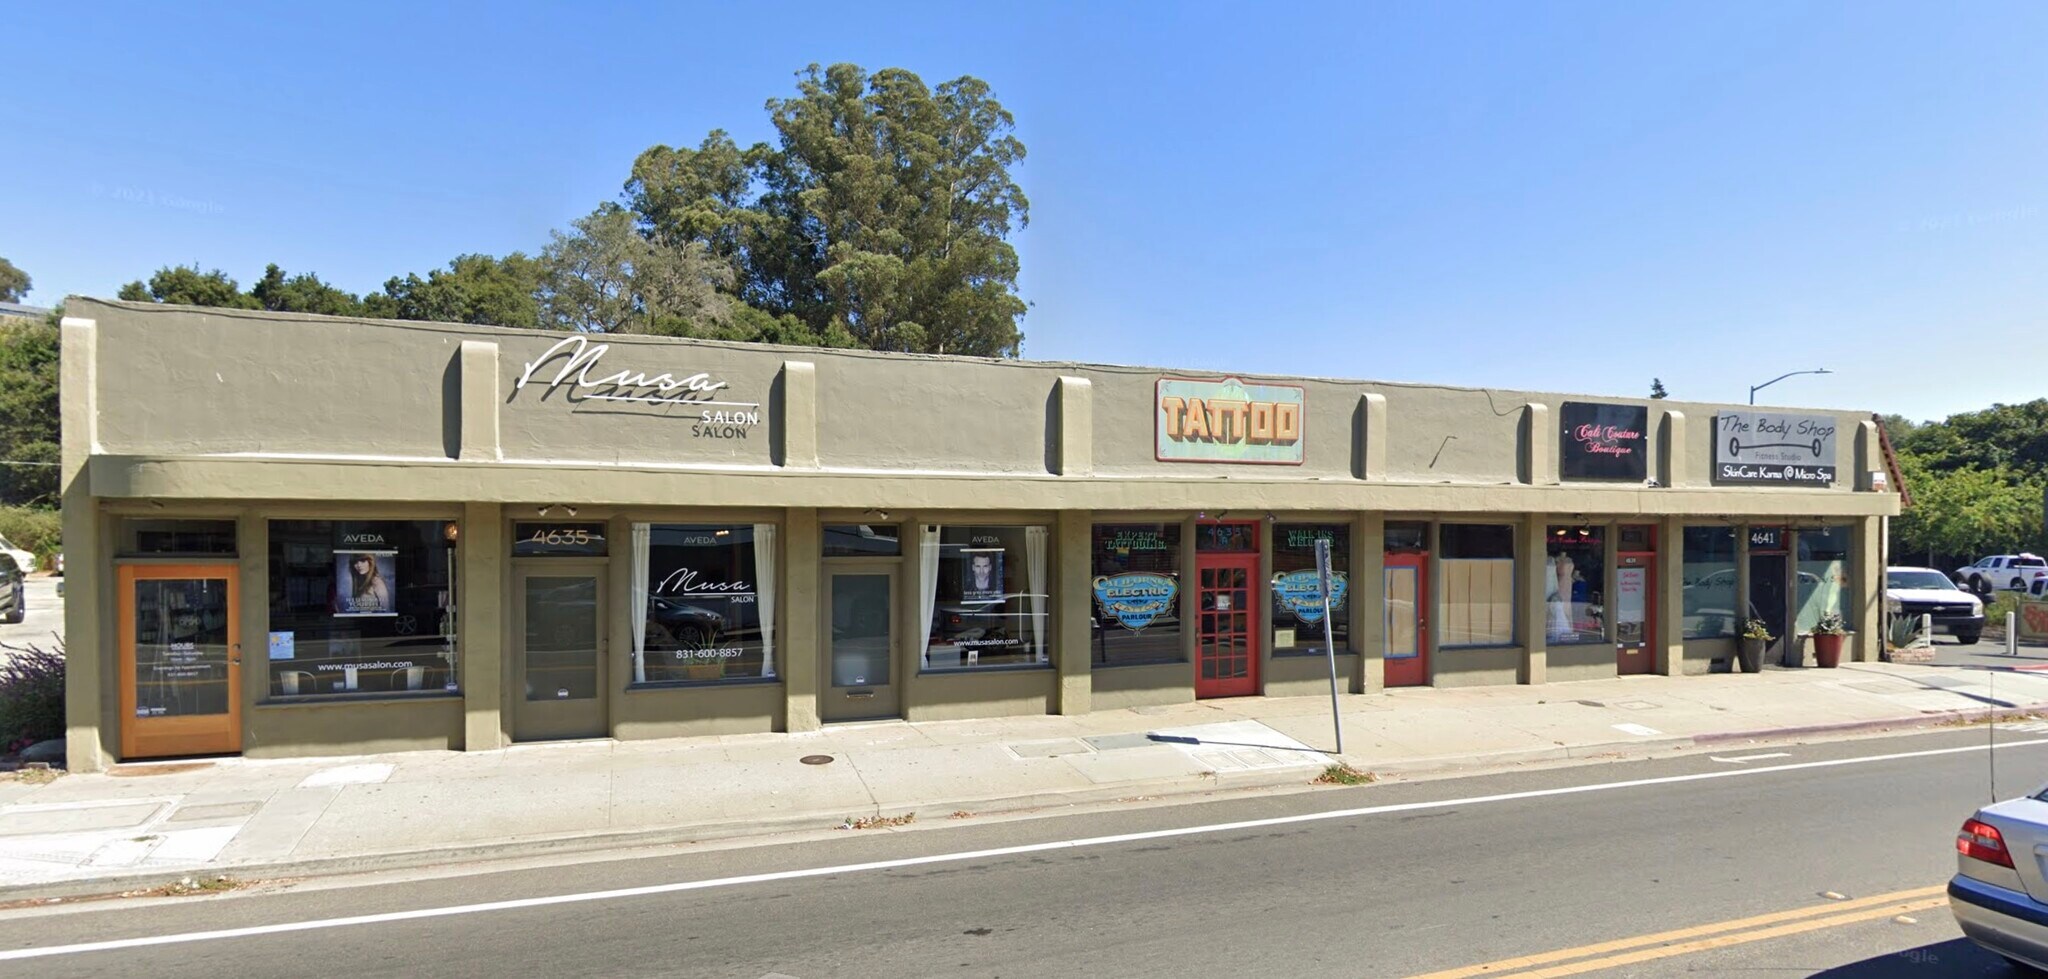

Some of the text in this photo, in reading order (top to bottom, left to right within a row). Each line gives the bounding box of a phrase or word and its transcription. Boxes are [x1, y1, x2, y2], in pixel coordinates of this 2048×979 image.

[517, 335, 727, 392] Musa
[702, 410, 758, 425] SALON
[1162, 397, 1299, 445] TATTOO
[1574, 423, 1640, 442] Cali Couture
[1720, 415, 1835, 440] The Body Shop
[1585, 441, 1633, 458] Boutique
[1755, 452, 1802, 461] Fitness Studio
[1723, 465, 1758, 478] SkinCare
[1758, 466, 1783, 479] Karma
[1795, 467, 1815, 480] Micro
[1816, 468, 1832, 481] Spa
[344, 534, 385, 543] AVEDA
[532, 530, 590, 546] 4635
[1207, 528, 1242, 537] 4635
[1751, 533, 1774, 544] 4641
[684, 536, 718, 544] AVEDA
[657, 567, 750, 594] Musa
[1107, 587, 1169, 597] ELECTRIC
[954, 639, 1018, 647] www.musasalon.com
[676, 648, 743, 659] 831-600-8857
[318, 661, 413, 671] www.musasalon.com
